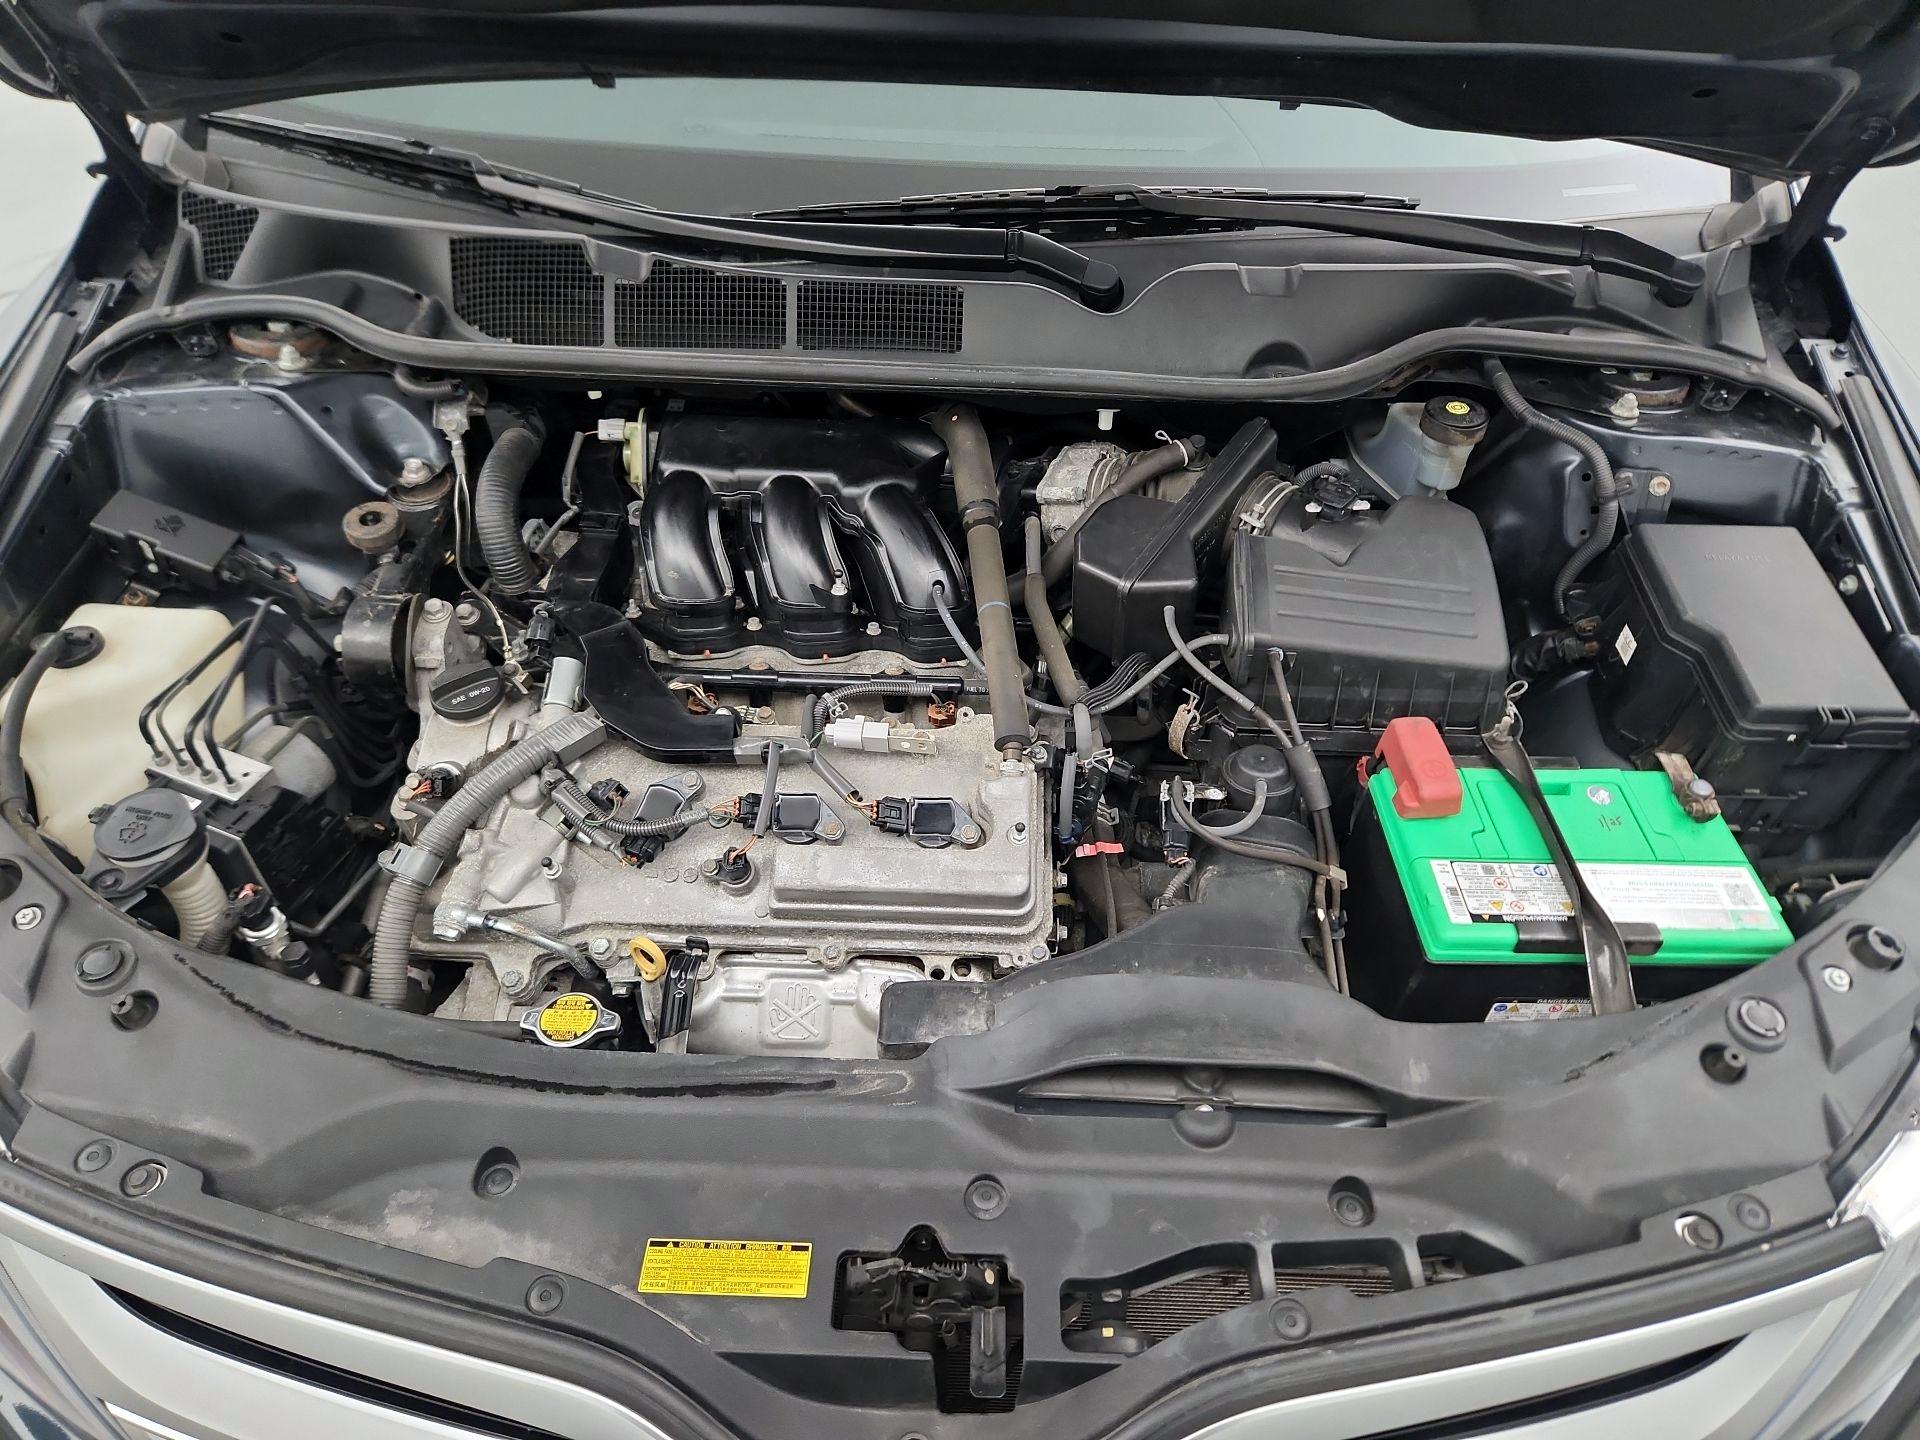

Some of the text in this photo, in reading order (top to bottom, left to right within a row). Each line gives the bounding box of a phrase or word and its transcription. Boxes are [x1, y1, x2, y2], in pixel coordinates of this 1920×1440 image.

[451, 686, 491, 705] SAE 0W-20
[678, 1241, 741, 1250] CAUTION ATTENTION
